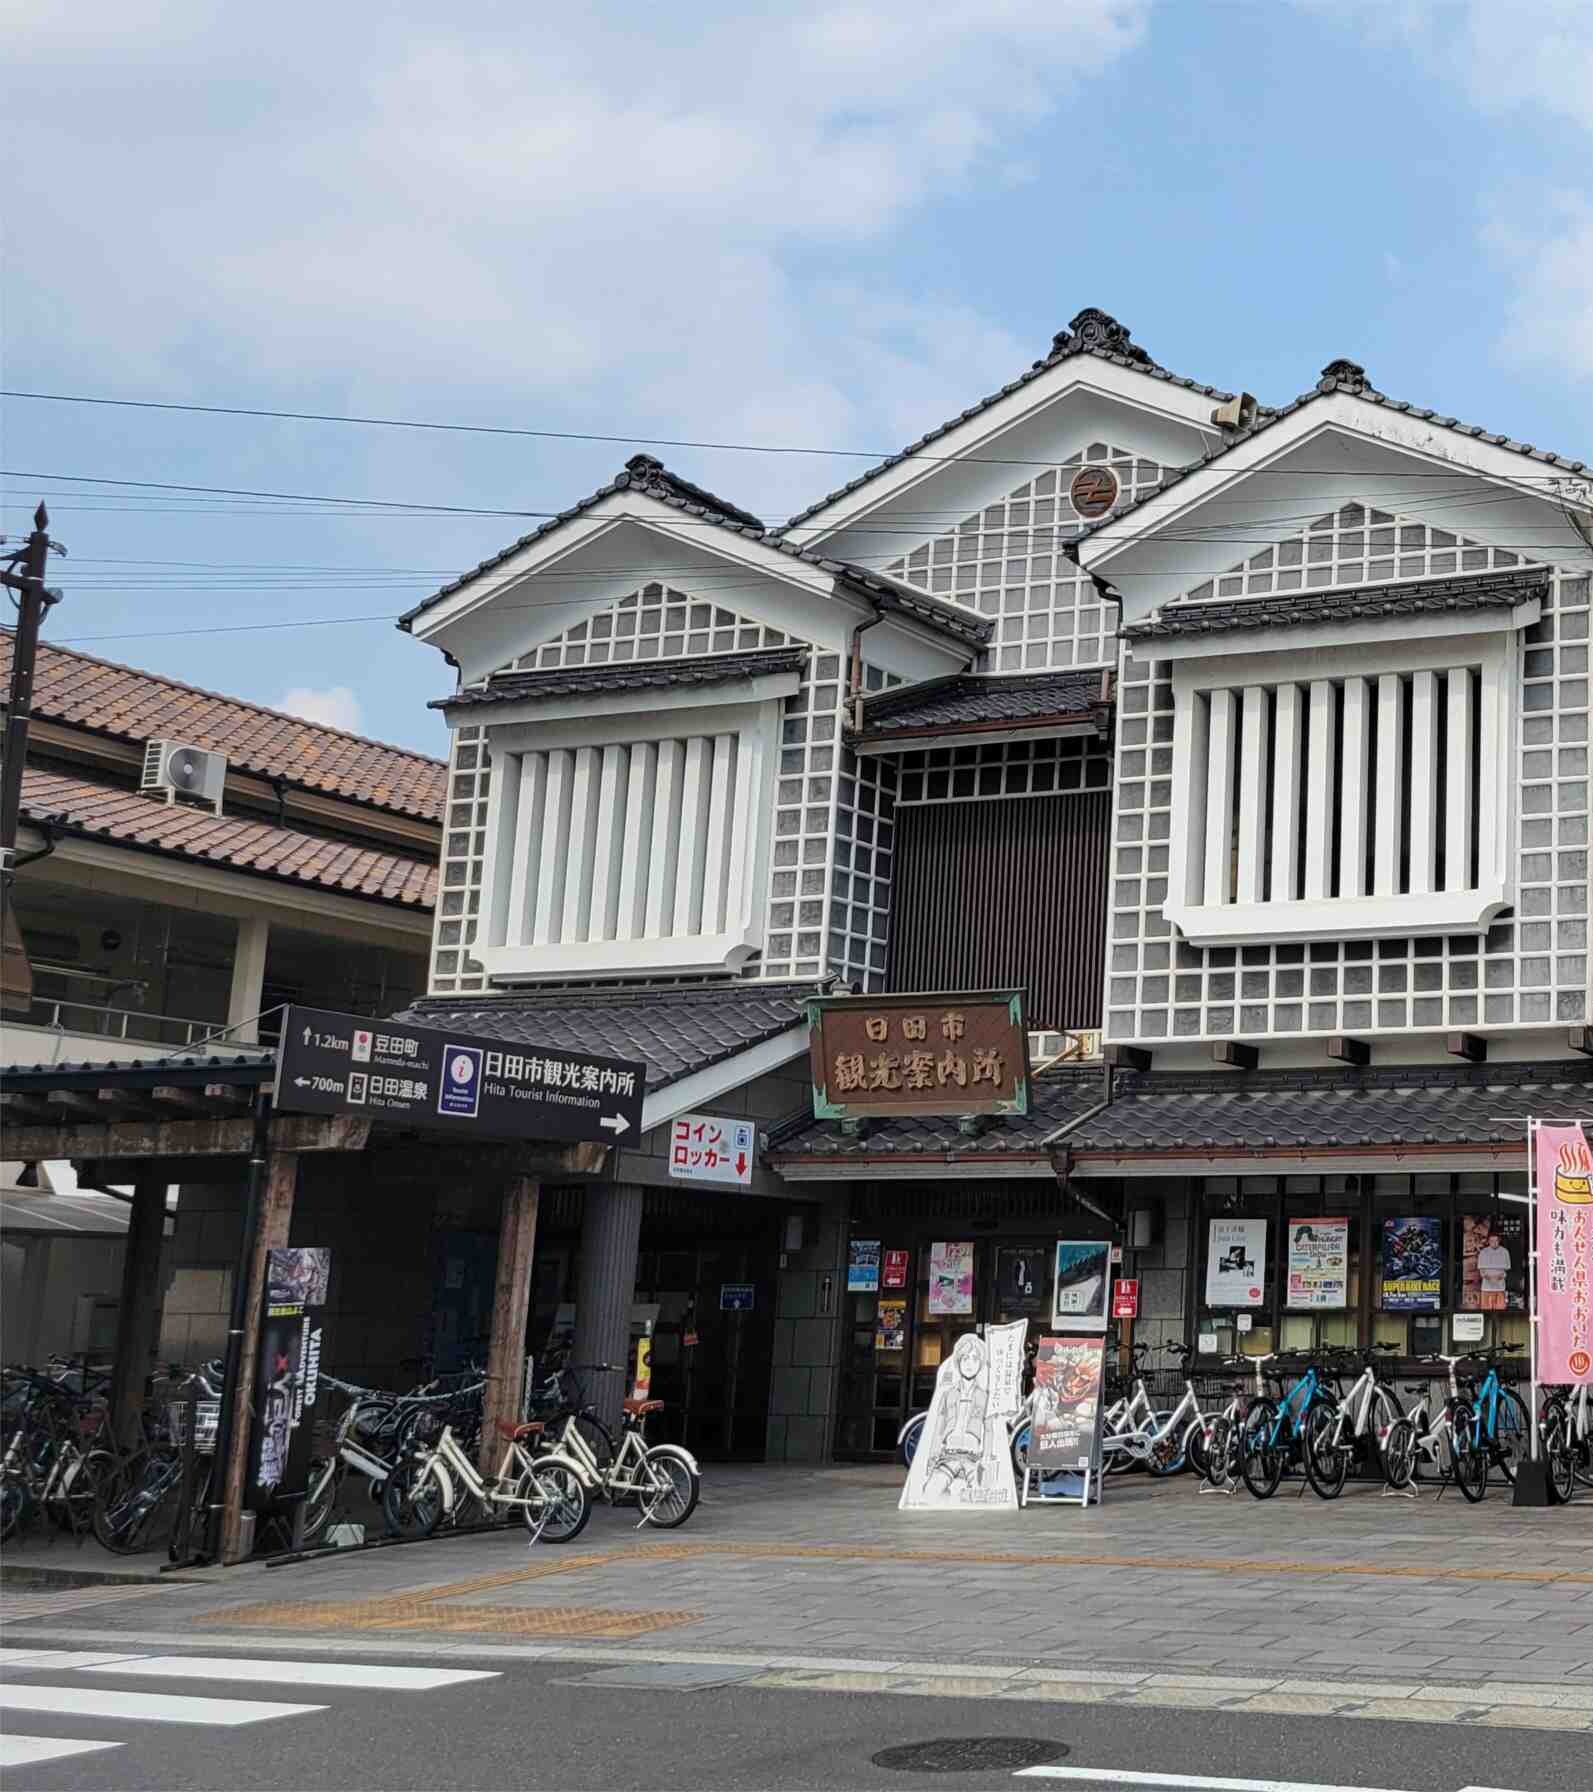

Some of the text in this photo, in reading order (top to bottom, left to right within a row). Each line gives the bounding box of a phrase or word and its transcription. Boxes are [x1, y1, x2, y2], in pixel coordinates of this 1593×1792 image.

[865, 1012, 966, 1042] 日田市
[314, 1033, 349, 1051] 1.2km
[375, 1034, 419, 1058] 豆田町
[484, 1050, 636, 1097] 日田市観光案内所
[835, 1047, 1004, 1091] 観光案内所
[311, 1076, 345, 1094] 700m
[370, 1075, 428, 1100] 日田温泉
[484, 1082, 601, 1108] Hita Tourist Information
[676, 1121, 722, 1143] コイン
[674, 1146, 730, 1168] ロッカー
[304, 1327, 322, 1406] OKUHITA
